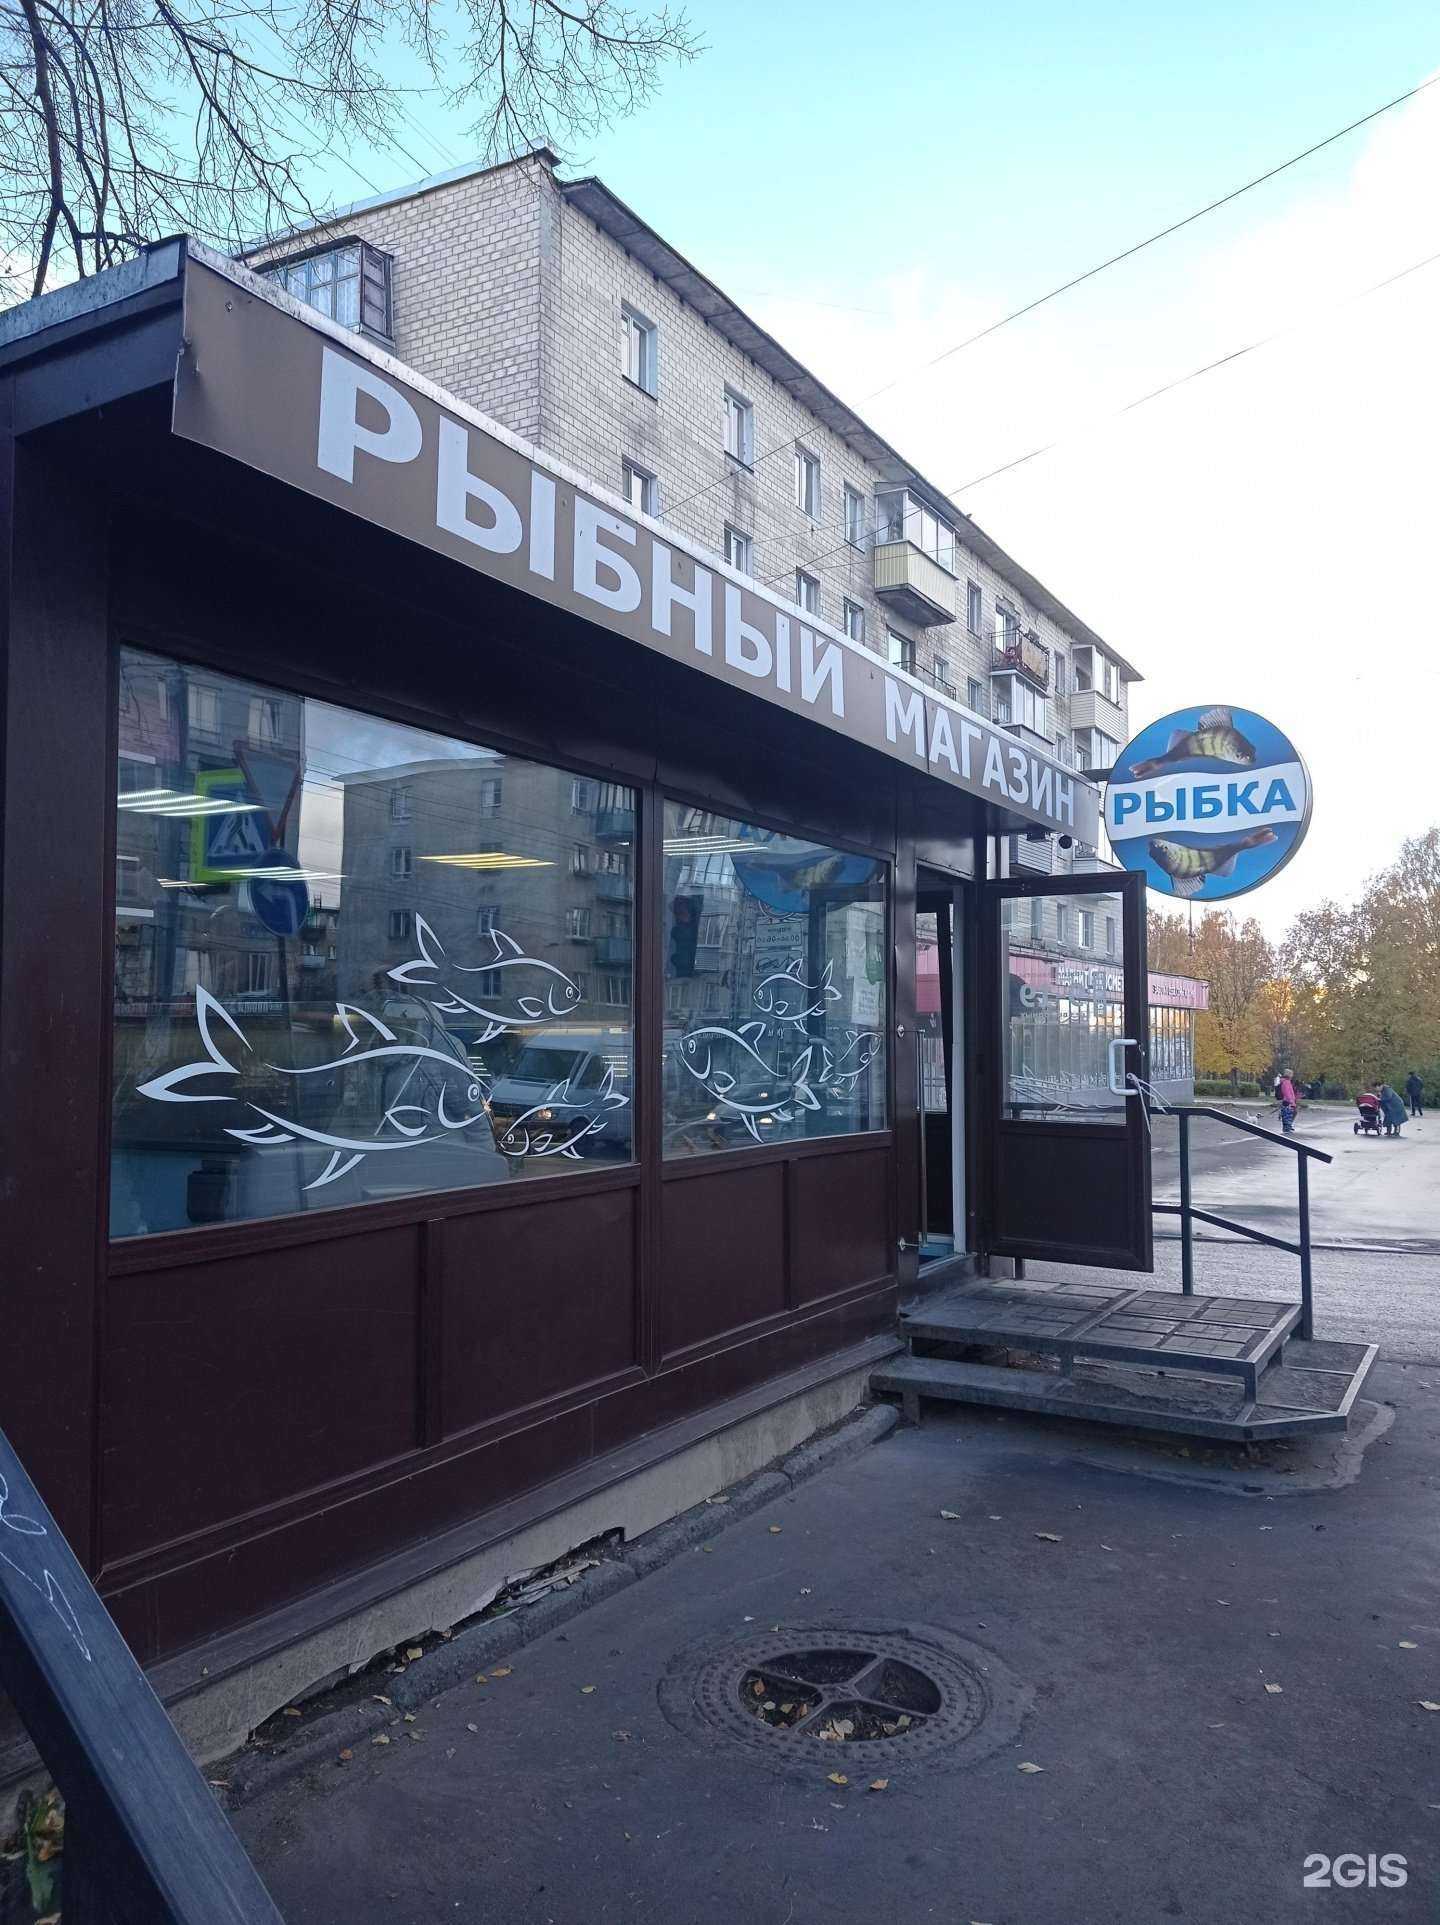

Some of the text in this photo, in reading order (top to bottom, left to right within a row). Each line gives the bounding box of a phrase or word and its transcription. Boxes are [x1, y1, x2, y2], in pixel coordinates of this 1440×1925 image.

[317, 345, 1075, 828] РЫБНЫЙ МАГАЗИН
[1113, 778, 1297, 826] РЫБКА
